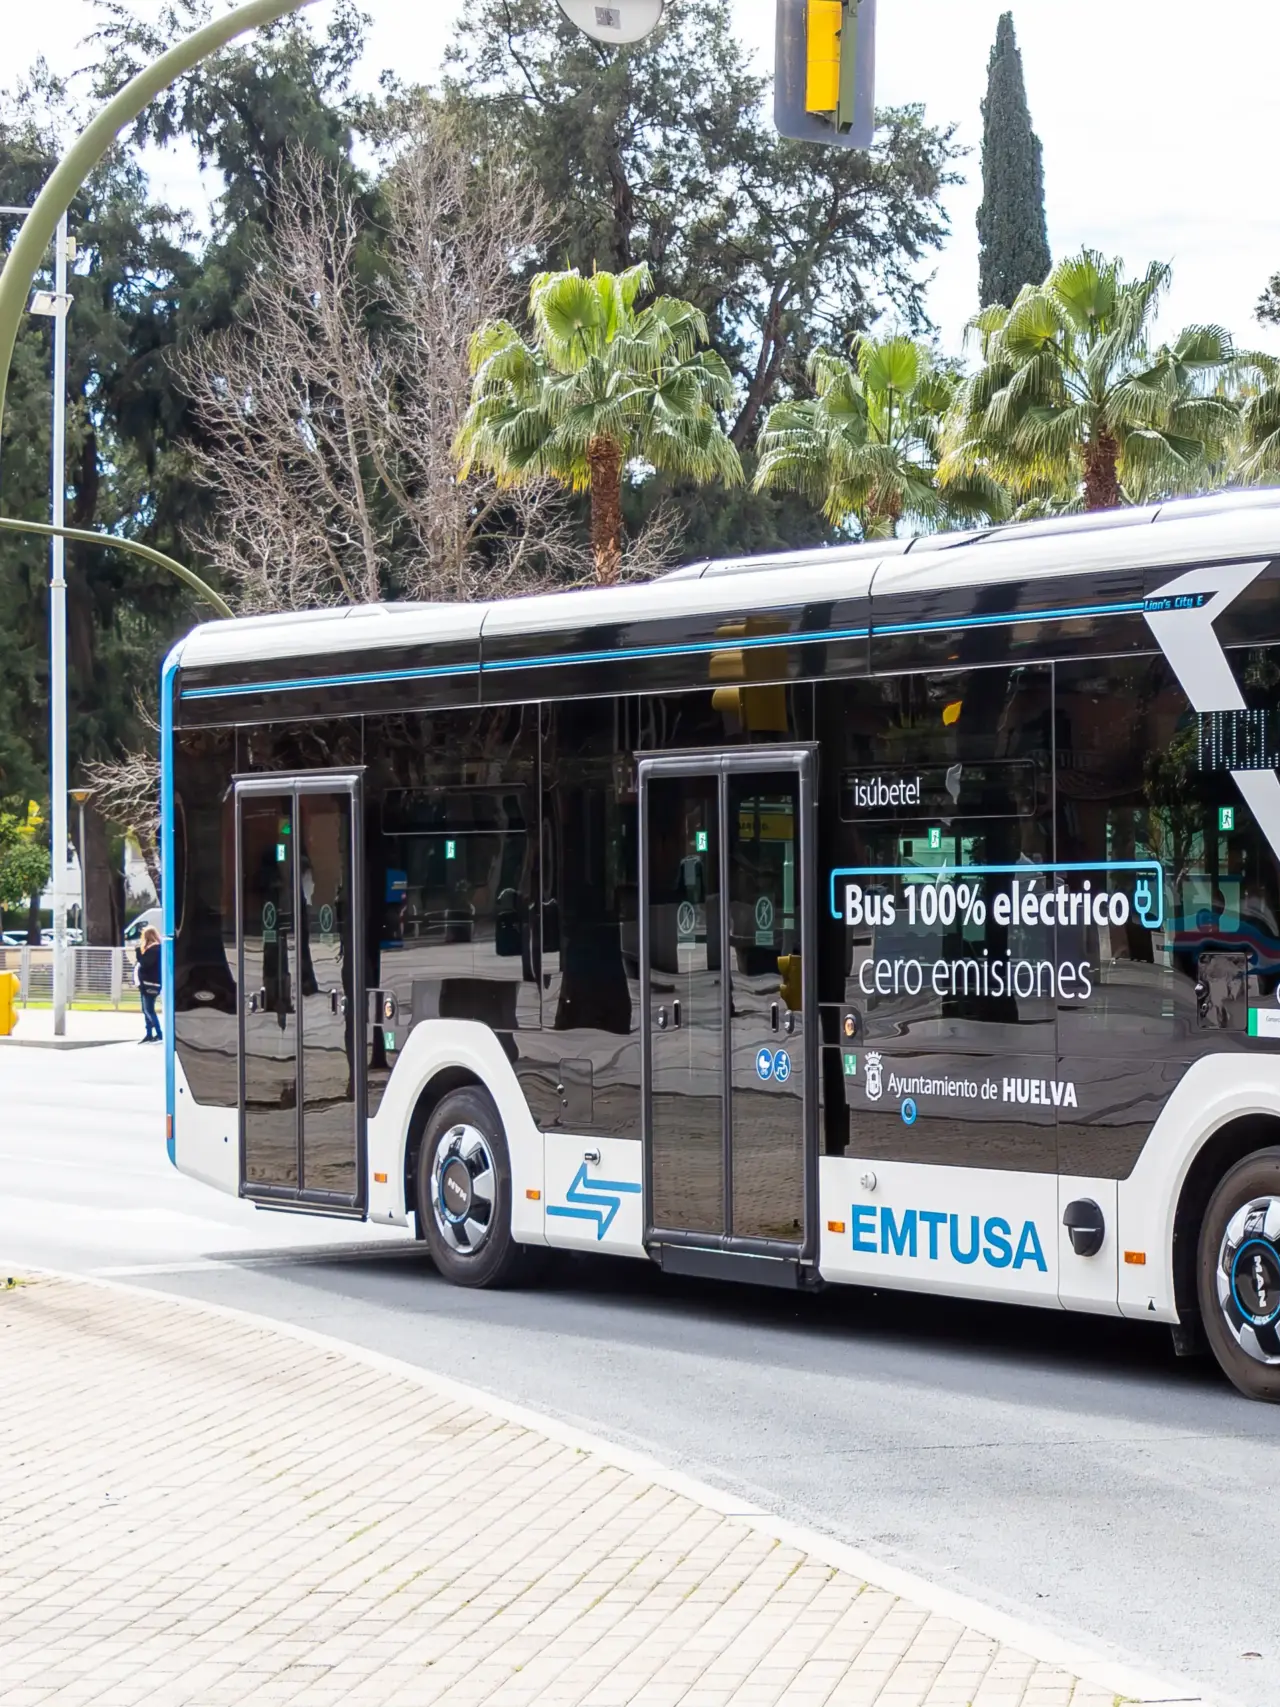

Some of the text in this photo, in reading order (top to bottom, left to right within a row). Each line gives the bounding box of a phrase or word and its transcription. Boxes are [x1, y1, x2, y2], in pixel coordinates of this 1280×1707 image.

[1144, 594, 1205, 611] Lion's City E
[845, 879, 1130, 926] Bus 100% eléctrico
[858, 948, 1092, 1000] cero emisiones
[886, 1072, 1079, 1108] Ayuntamiento de HUELVA
[851, 1203, 1049, 1273] EMTUSA
[1254, 1255, 1267, 1308] MAN
